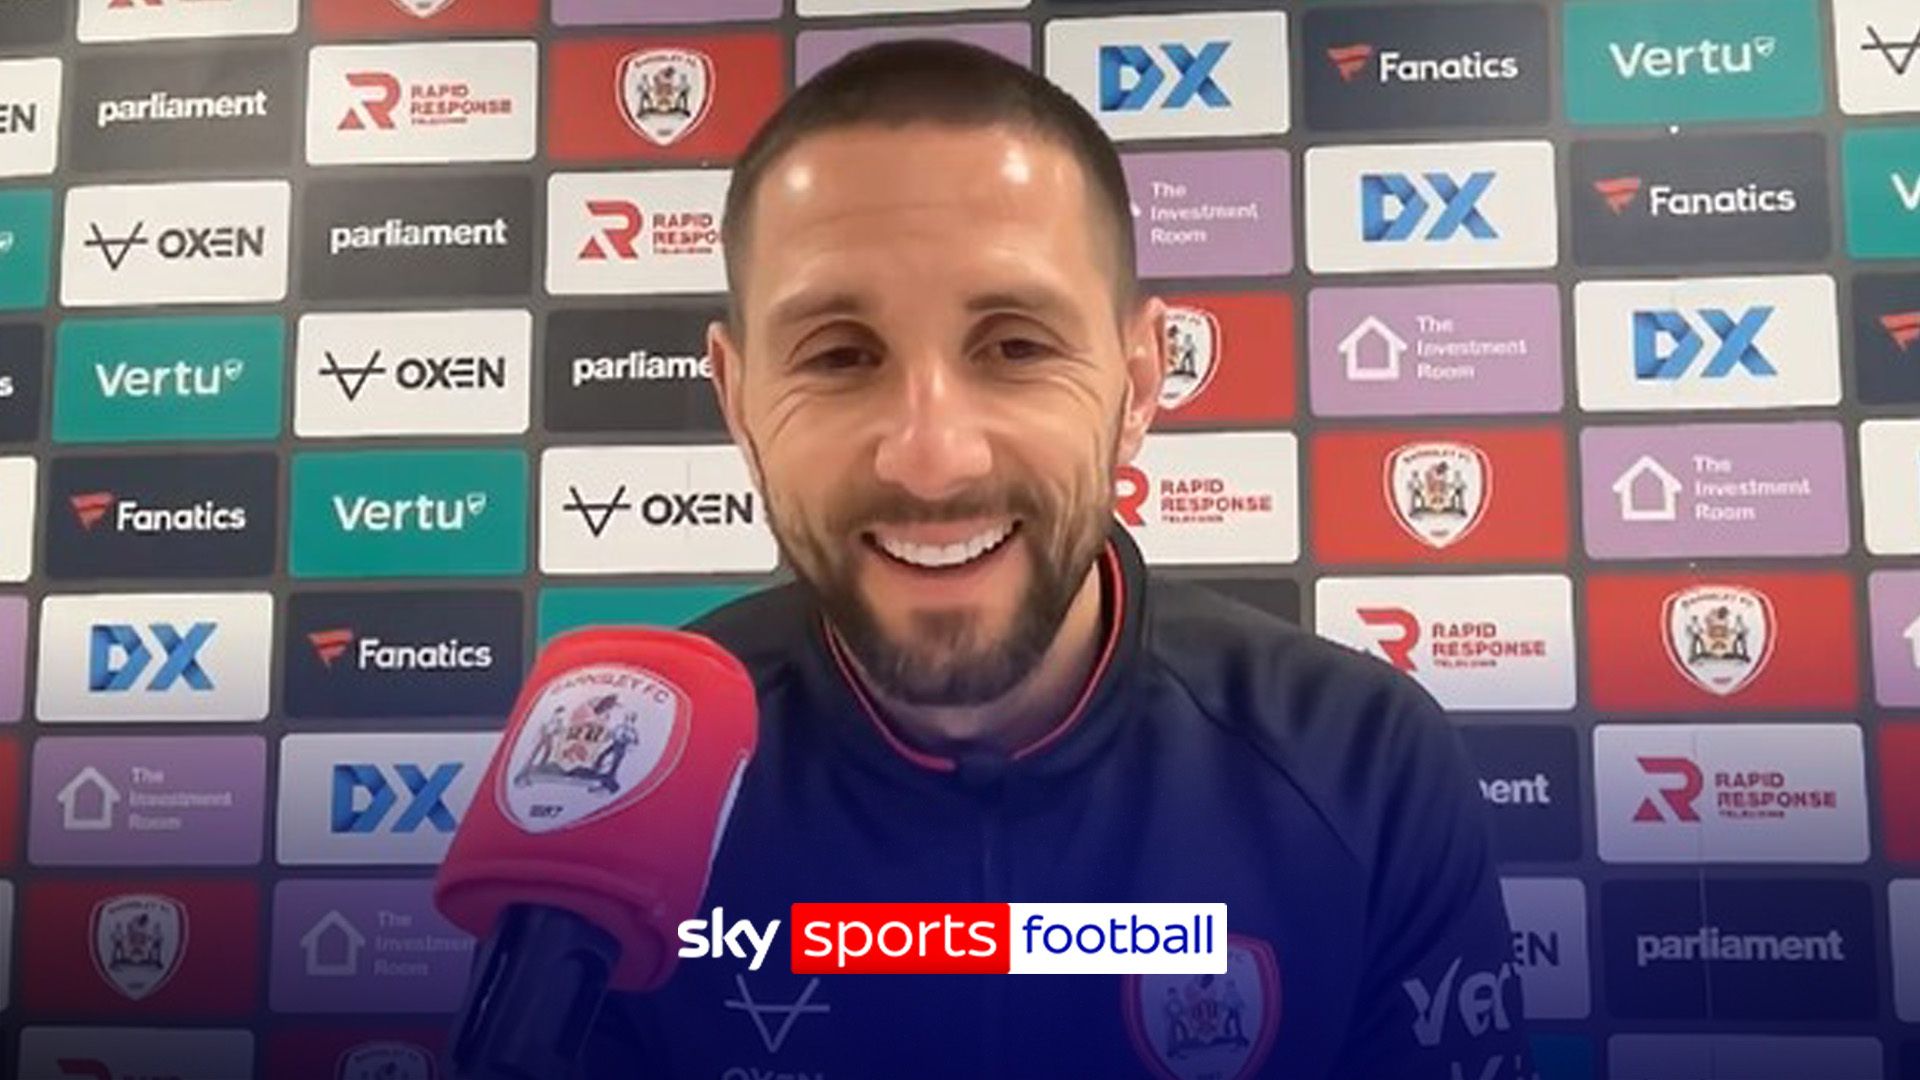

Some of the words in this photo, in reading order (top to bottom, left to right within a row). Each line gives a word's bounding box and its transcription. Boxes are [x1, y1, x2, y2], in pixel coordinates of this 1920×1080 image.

[1381, 52, 1518, 81] Fanatics
[1610, 40, 1751, 77] Vertu
[1099, 40, 1231, 111] DX
[411, 84, 469, 98] RAPID
[99, 91, 266, 126] parliament
[411, 100, 511, 115] RESPONSE
[1153, 182, 1186, 197] The
[1650, 184, 1795, 215] Fanatics
[653, 213, 713, 228] RAPID
[1361, 173, 1497, 242] DX
[158, 227, 264, 258] OXEN
[331, 219, 506, 254] parliament
[1151, 228, 1206, 243] Room
[1417, 316, 1452, 332] The
[1633, 307, 1776, 380] DX
[96, 361, 220, 396] Vertu
[397, 357, 505, 389] OXEN
[1418, 364, 1474, 379] Room
[1694, 455, 1731, 472] The
[1161, 479, 1224, 494] RAPID
[118, 501, 245, 530] Fanatics
[334, 495, 463, 530] Vertu
[642, 493, 752, 525] OXEN
[1161, 497, 1271, 512] RESPONSE
[1696, 503, 1755, 520] Room
[1432, 623, 1496, 638] RAPID
[89, 624, 216, 692] DX
[360, 639, 492, 668] Fanatics
[1433, 641, 1545, 656] RESPONSE
[1715, 773, 1784, 788] RAPID
[331, 764, 463, 832] DX
[1718, 792, 1835, 808] RESPONSE
[1637, 927, 1844, 966] parliament
